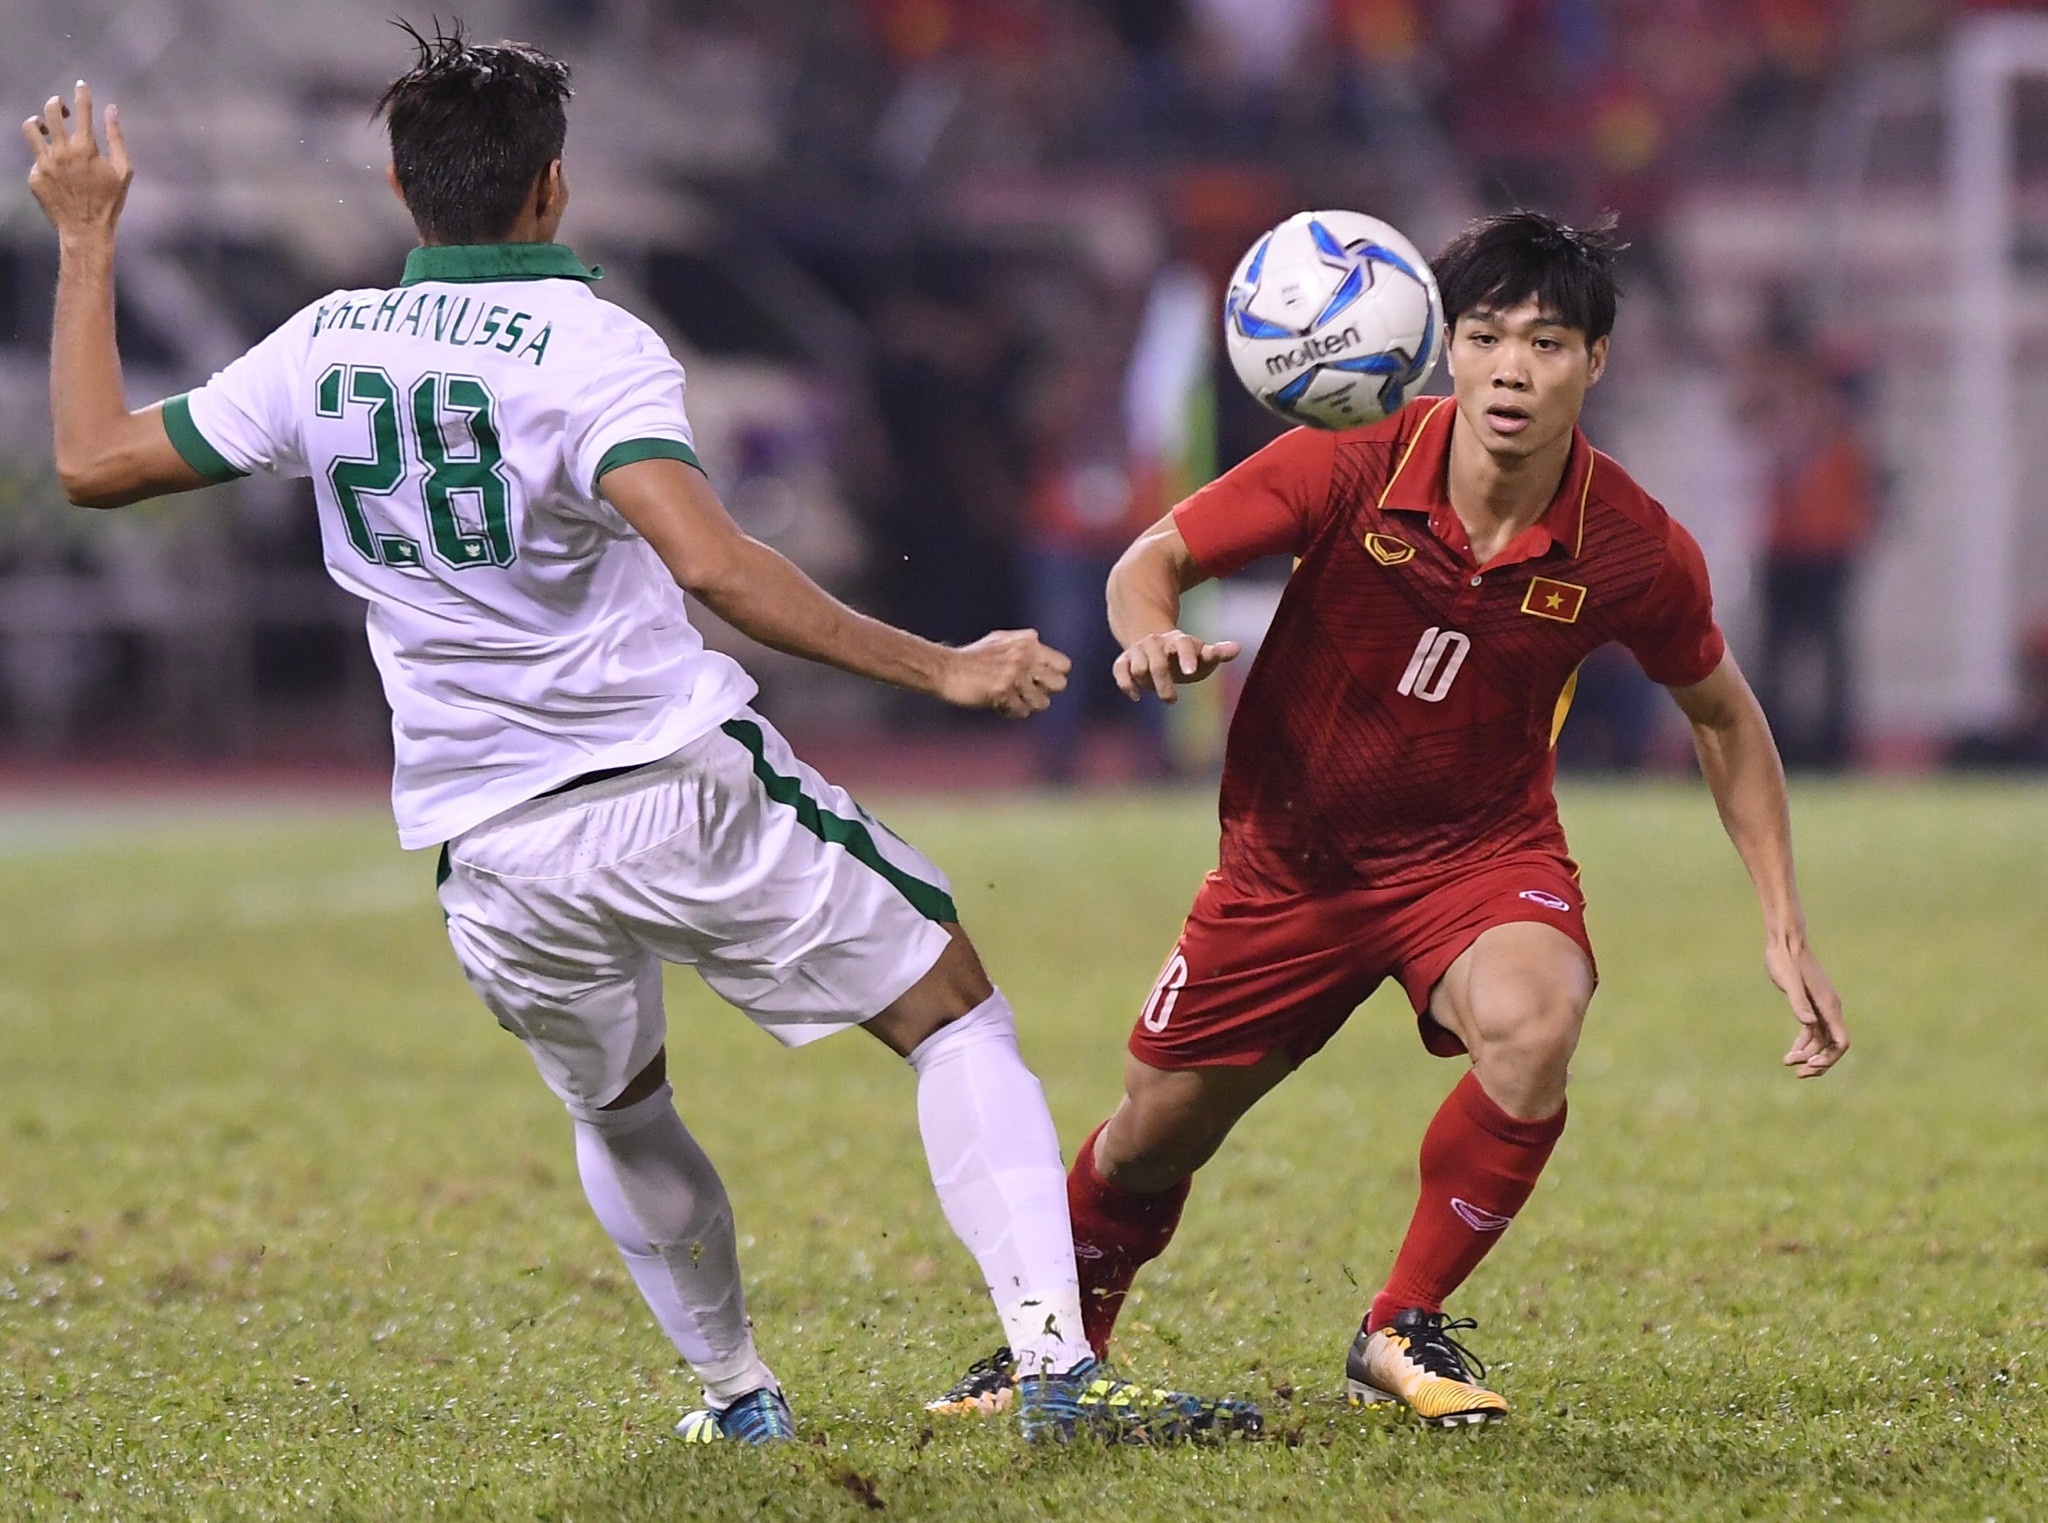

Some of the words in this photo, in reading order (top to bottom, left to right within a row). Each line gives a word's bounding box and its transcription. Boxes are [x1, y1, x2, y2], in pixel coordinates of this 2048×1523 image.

[1265, 325, 1362, 376] molten
[315, 362, 518, 570] 28
[1397, 626, 1471, 703] 10
[1140, 945, 1188, 1033] 0
